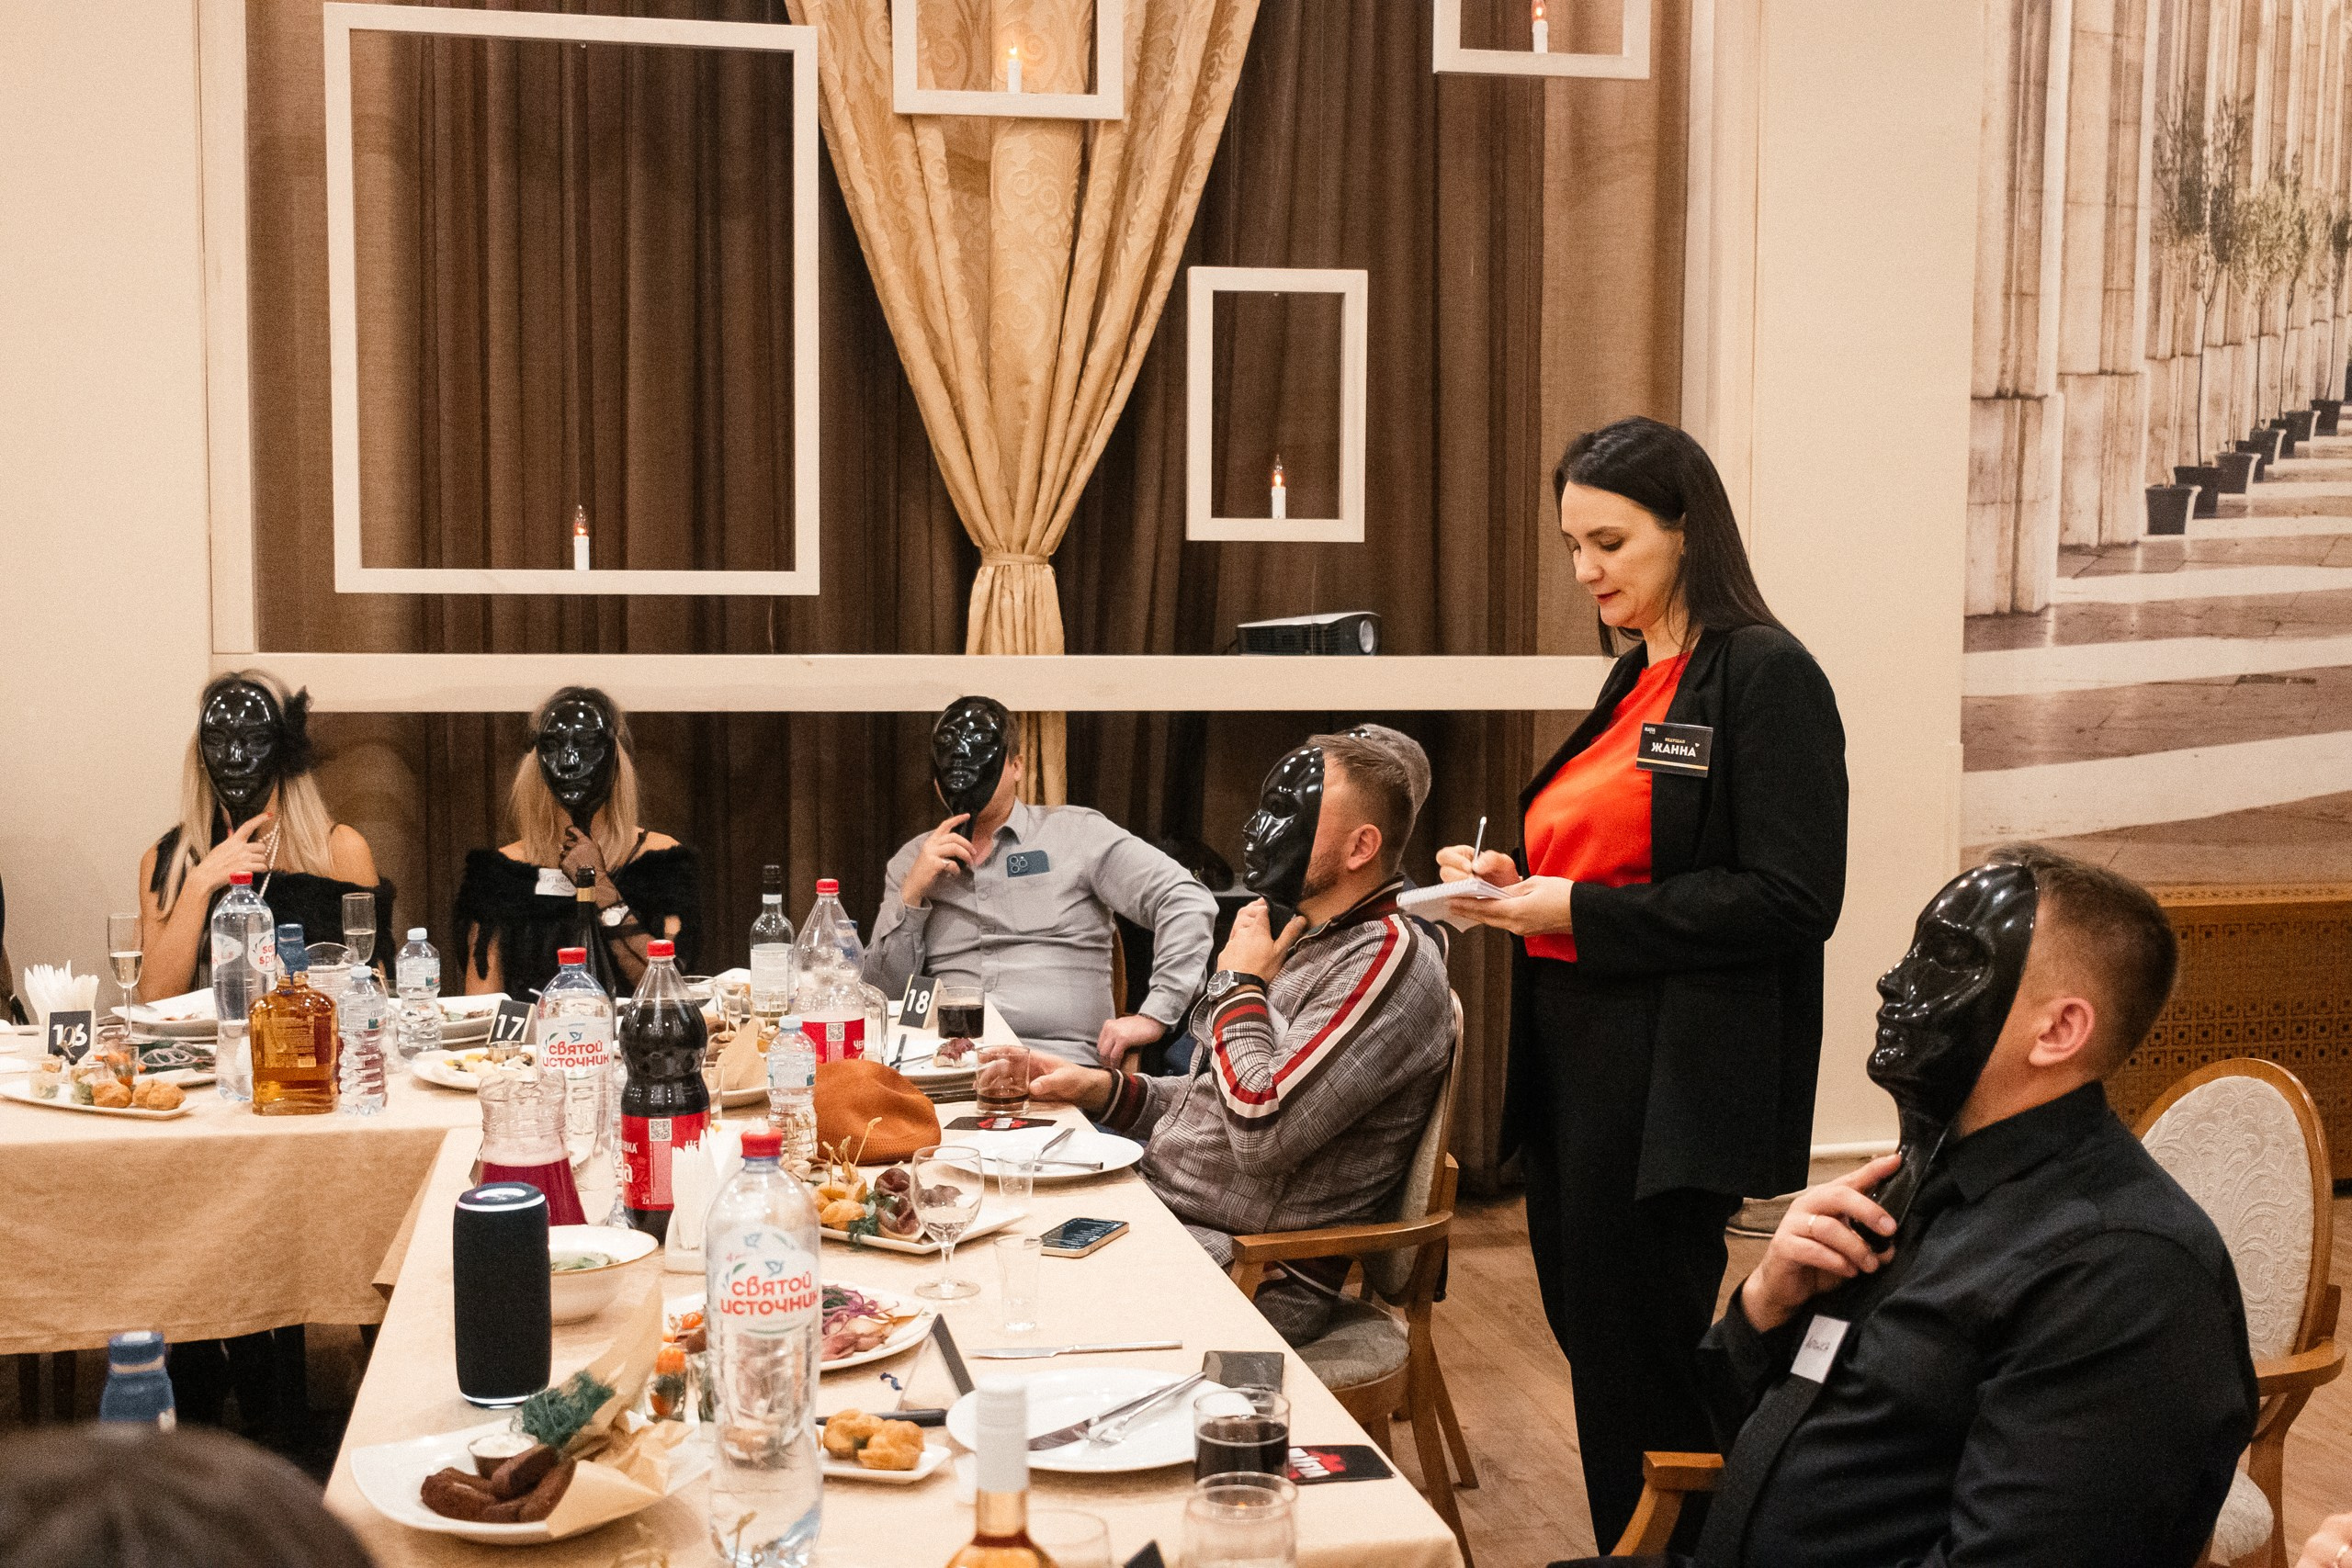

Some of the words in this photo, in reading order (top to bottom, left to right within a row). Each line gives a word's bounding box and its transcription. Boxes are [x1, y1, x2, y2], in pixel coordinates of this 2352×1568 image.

[1650, 741, 1696, 758] ЖАННА
[907, 988, 931, 1014] 18
[52, 1022, 88, 1047] 16
[496, 1014, 526, 1041] 17
